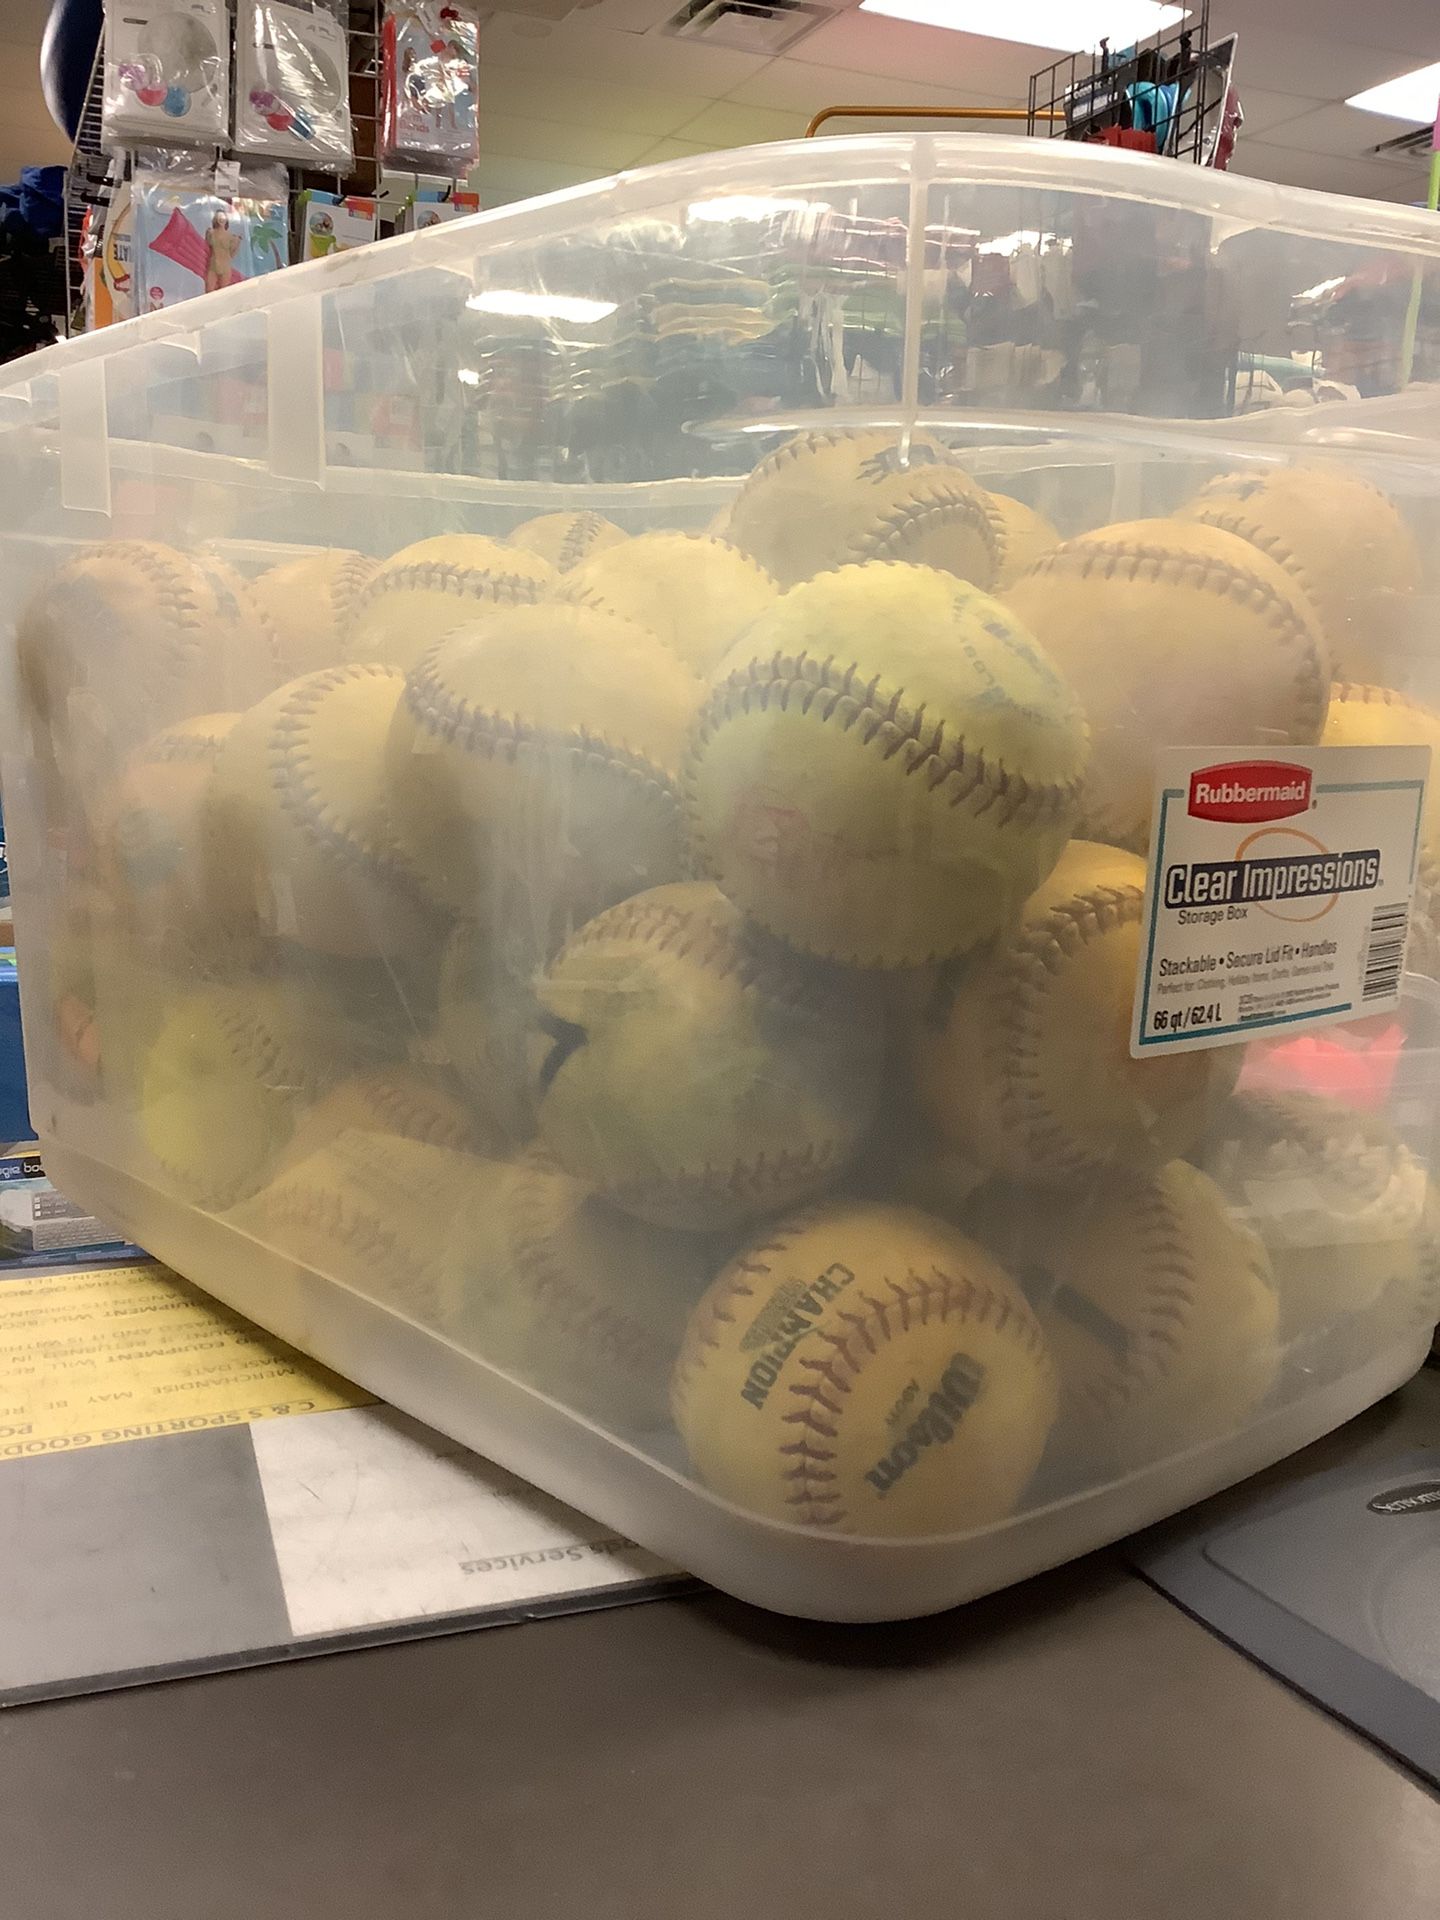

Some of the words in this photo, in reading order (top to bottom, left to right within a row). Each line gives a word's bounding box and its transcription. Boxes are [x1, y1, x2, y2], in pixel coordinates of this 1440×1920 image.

[1195, 781, 1306, 804] Rubbermaid
[1167, 864, 1238, 904] Clear
[1242, 853, 1378, 900] Impressions
[1178, 908, 1225, 926] Storage
[1227, 906, 1249, 920] Box
[1159, 954, 1217, 976] Stackable
[1226, 951, 1263, 969] Secure
[1154, 1010, 1169, 1030] 66
[740, 1262, 856, 1410] CHAMPION
[107, 1341, 225, 1363] EQUIPMENT
[153, 1367, 296, 1394] MERCHANDISE
[87, 1391, 133, 1404] MAY
[101, 1411, 241, 1441] SPORTING
[865, 1353, 986, 1491] Wilson
[0, 1434, 92, 1457] GOOD
[459, 1548, 583, 1576] Services
